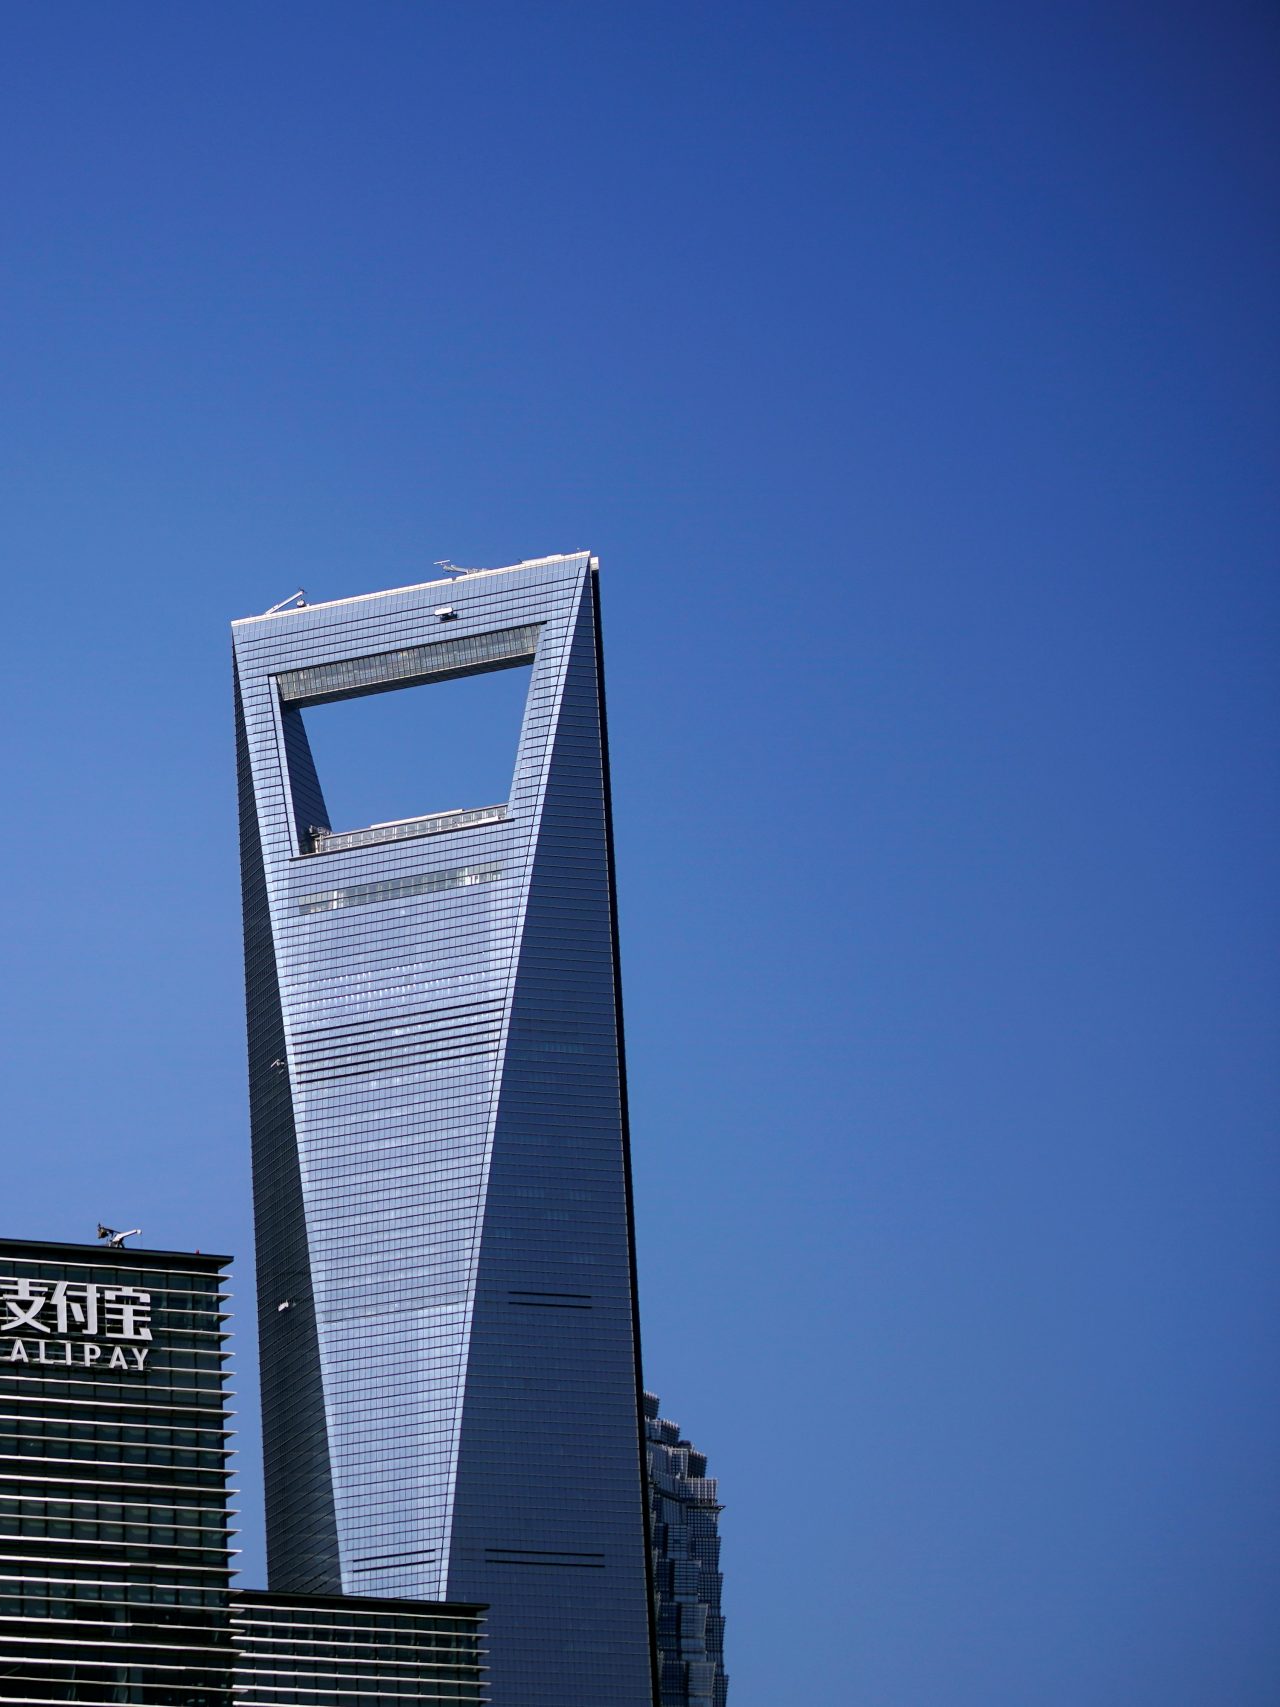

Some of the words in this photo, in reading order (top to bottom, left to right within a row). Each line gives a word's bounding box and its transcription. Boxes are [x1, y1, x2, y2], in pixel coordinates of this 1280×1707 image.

[0, 1278, 153, 1341] 支付宝
[10, 1339, 149, 1371] ALIPAY
